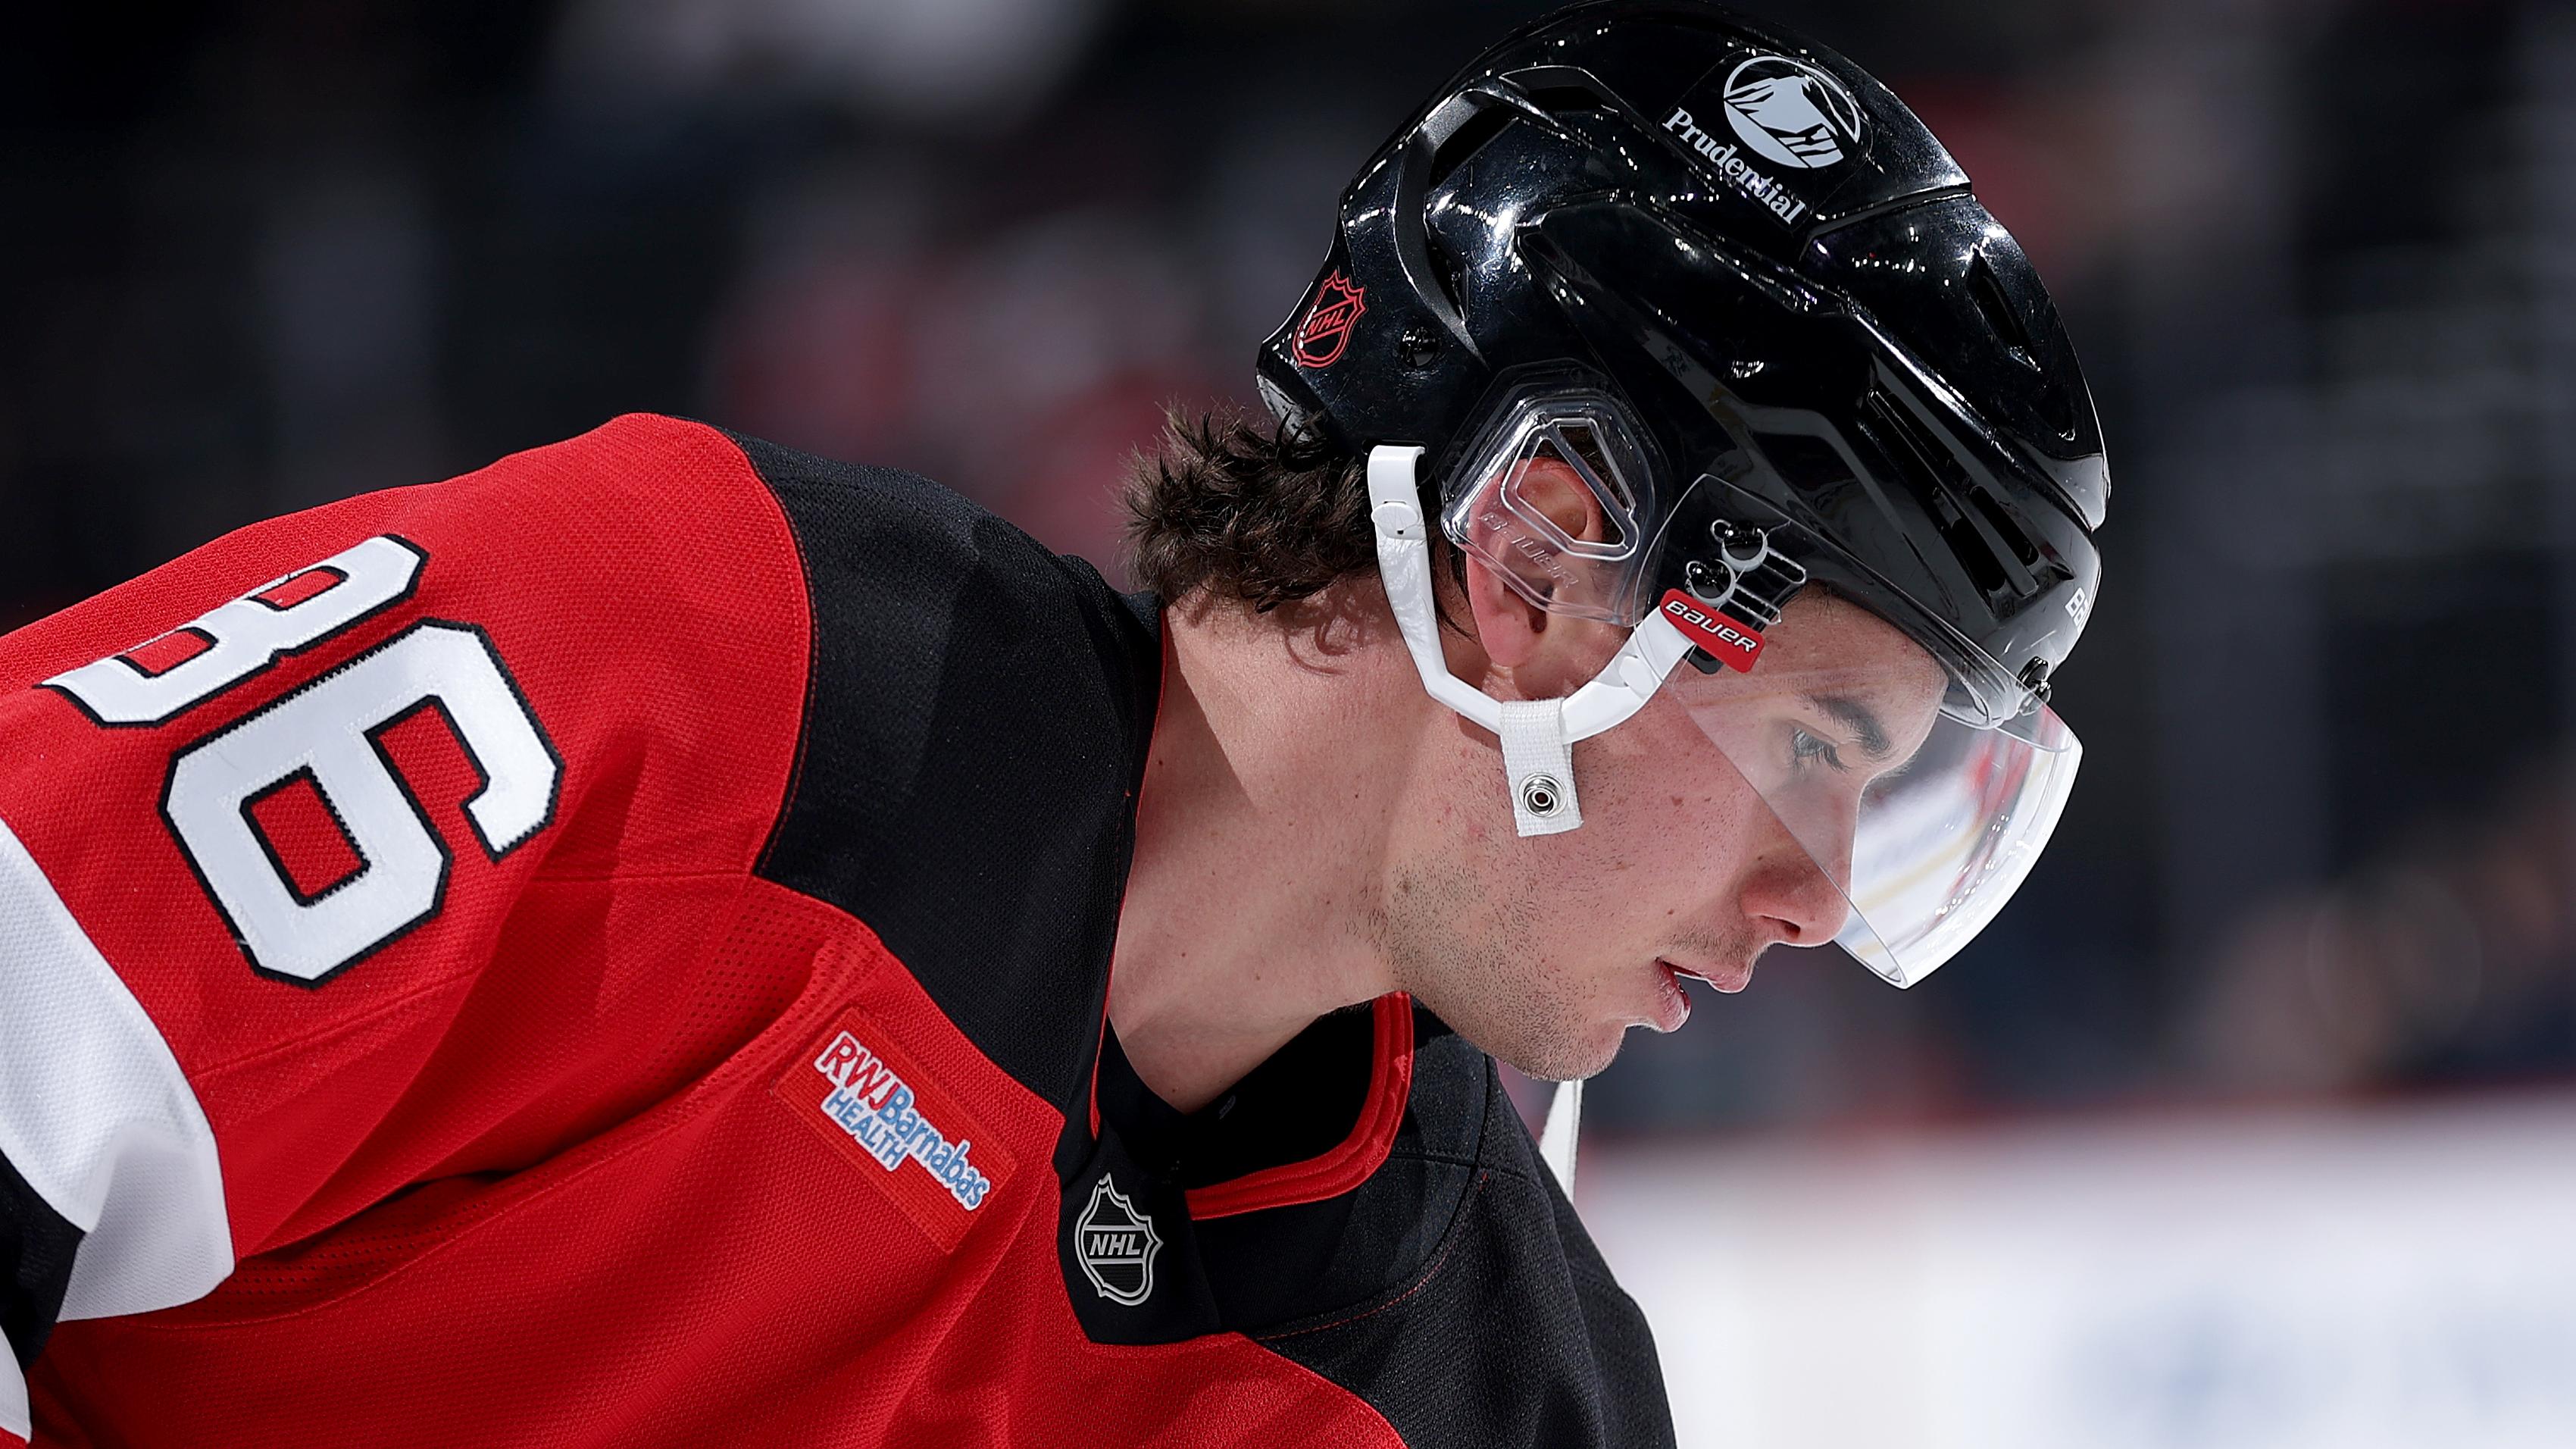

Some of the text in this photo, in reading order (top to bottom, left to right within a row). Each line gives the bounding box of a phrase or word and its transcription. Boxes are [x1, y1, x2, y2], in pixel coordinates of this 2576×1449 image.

[1662, 107, 1806, 224] Prudential
[1305, 308, 1344, 338] NHL
[826, 1089, 908, 1167] HEALTH
[1089, 1234, 1141, 1256] NHL
